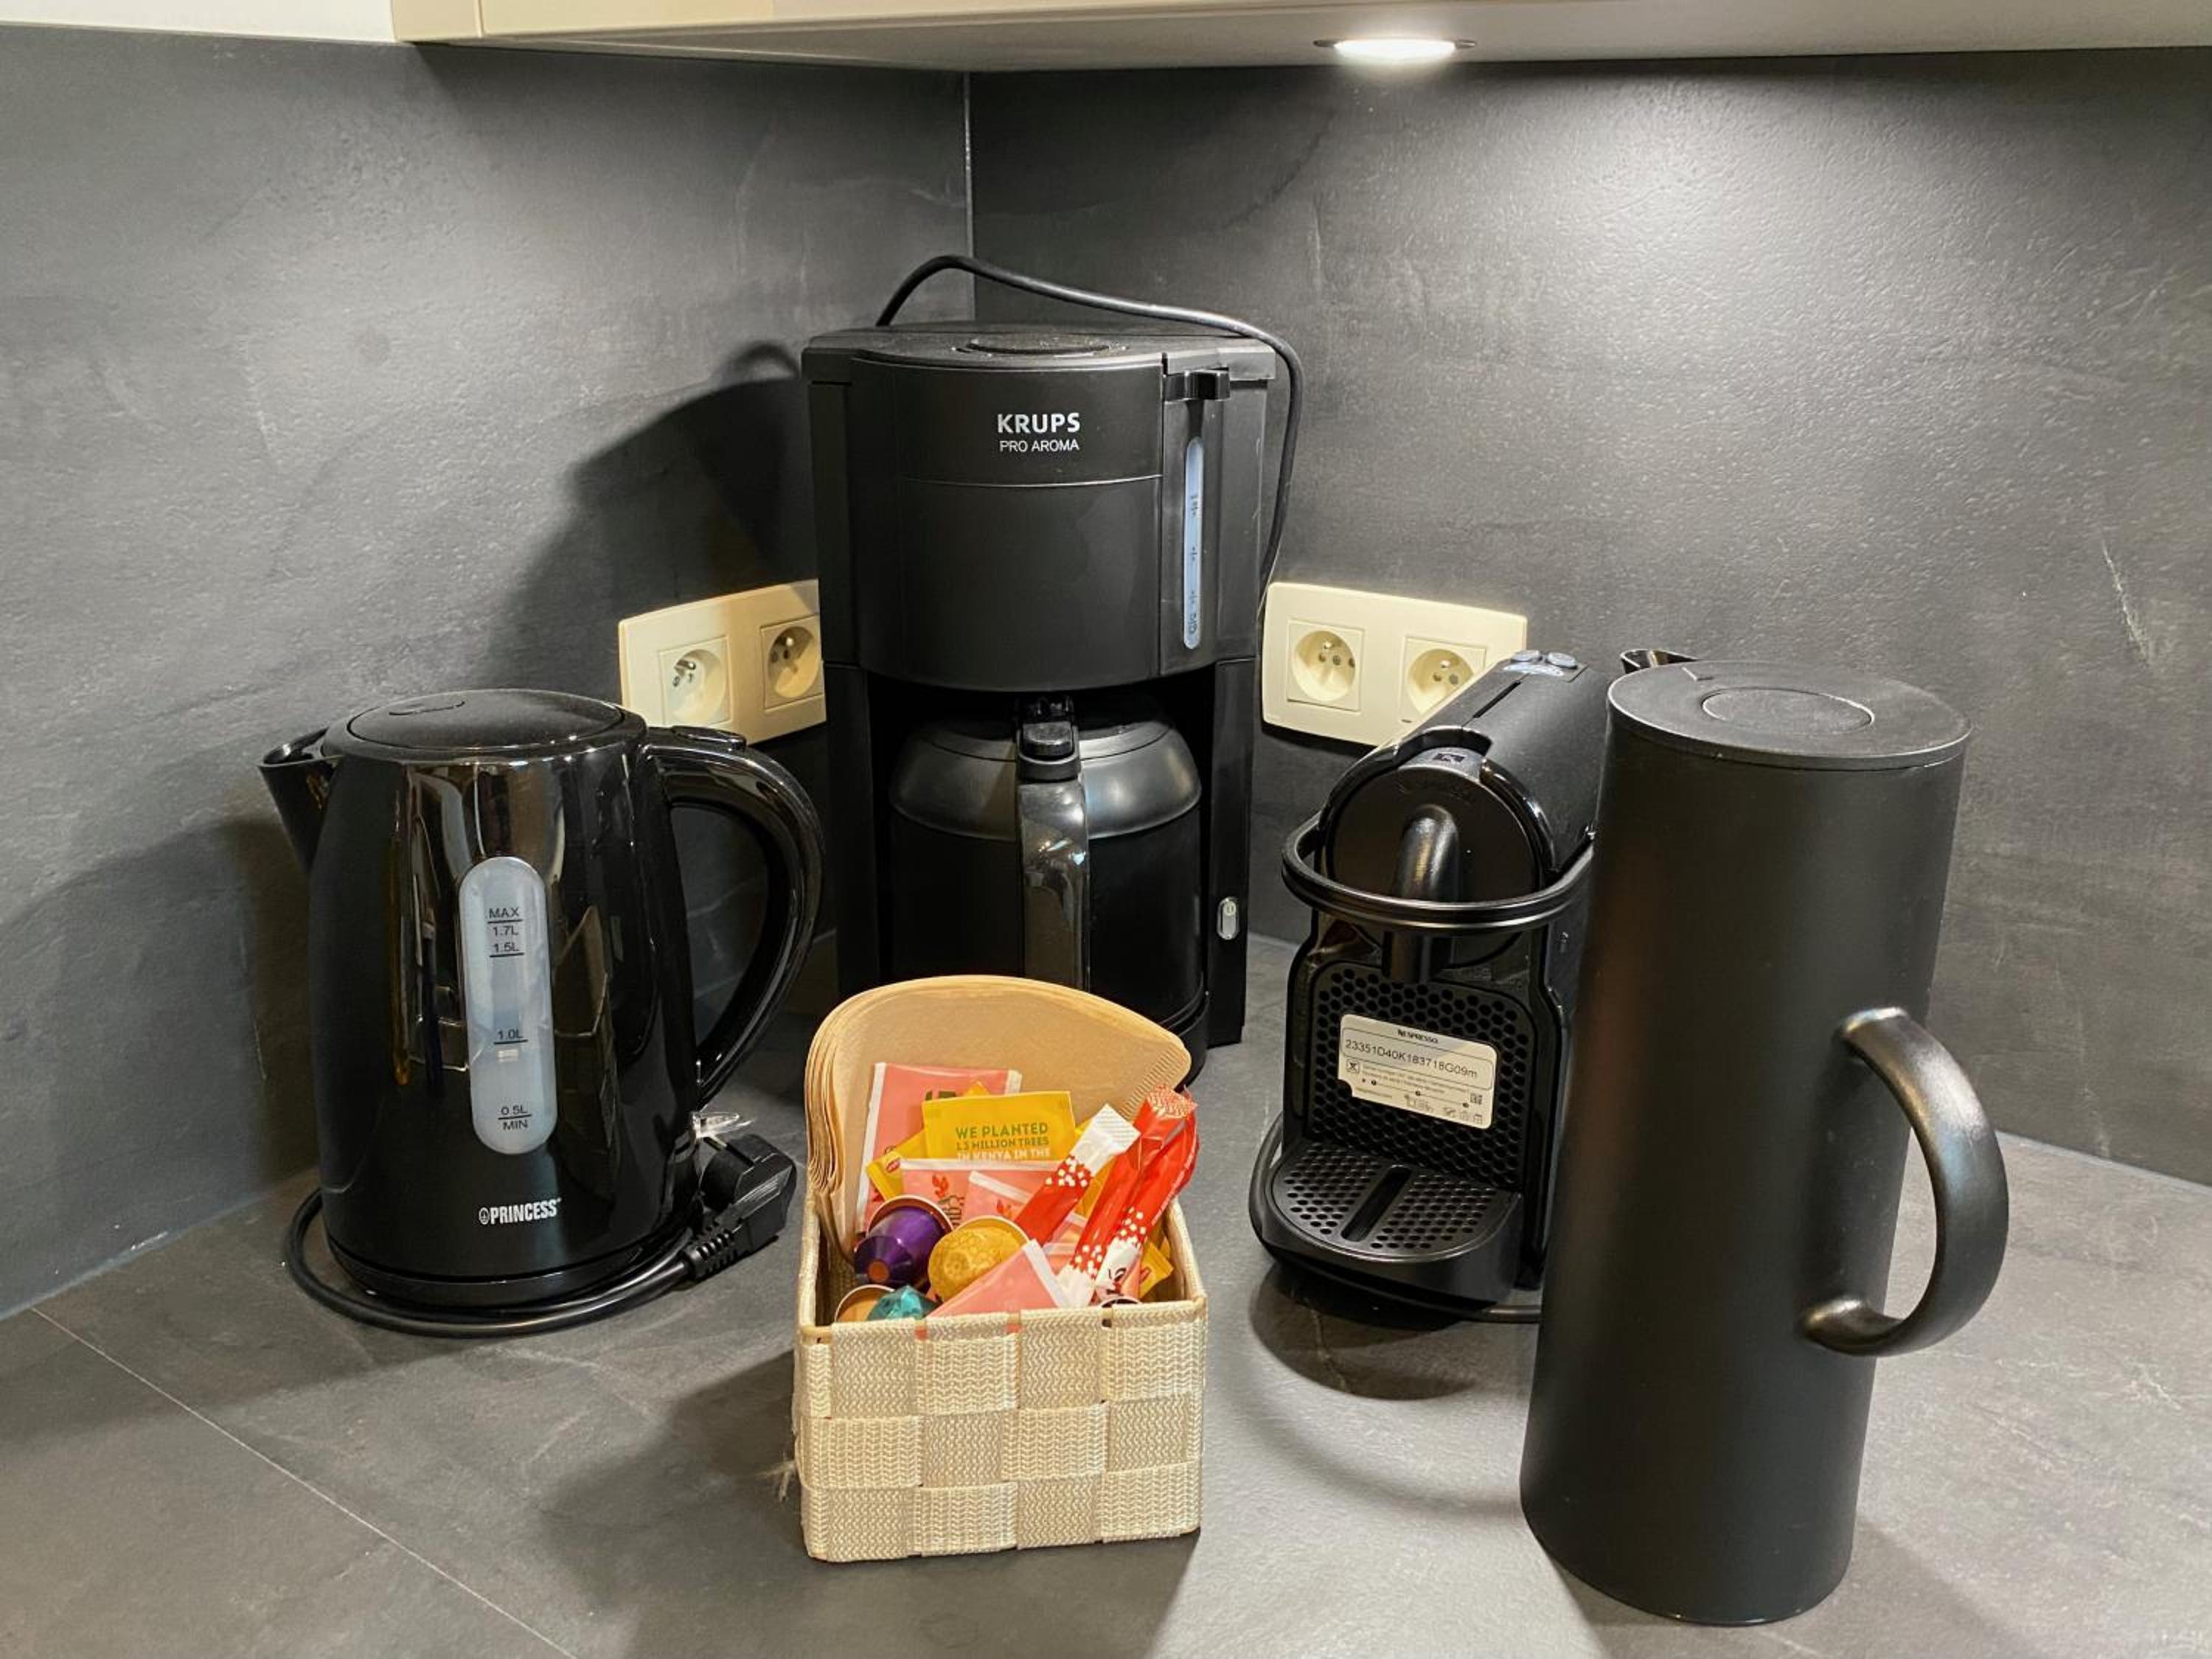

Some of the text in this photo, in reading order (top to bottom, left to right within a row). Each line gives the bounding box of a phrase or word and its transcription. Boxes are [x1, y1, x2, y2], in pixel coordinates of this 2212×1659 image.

[997, 412, 1081, 434] KRUPS
[999, 439, 1080, 452] PRO AROMA
[489, 907, 520, 919] MAX
[493, 925, 519, 936] 1.7L
[494, 942, 520, 953] 1.5L
[497, 1029, 524, 1040] 1.0L
[502, 1119, 529, 1131] MIN
[956, 1122, 1048, 1139] WE PLANTED
[972, 1138, 1016, 1150] MILLION
[1018, 1136, 1050, 1147] TREES
[490, 1199, 557, 1225] PRINCESS
